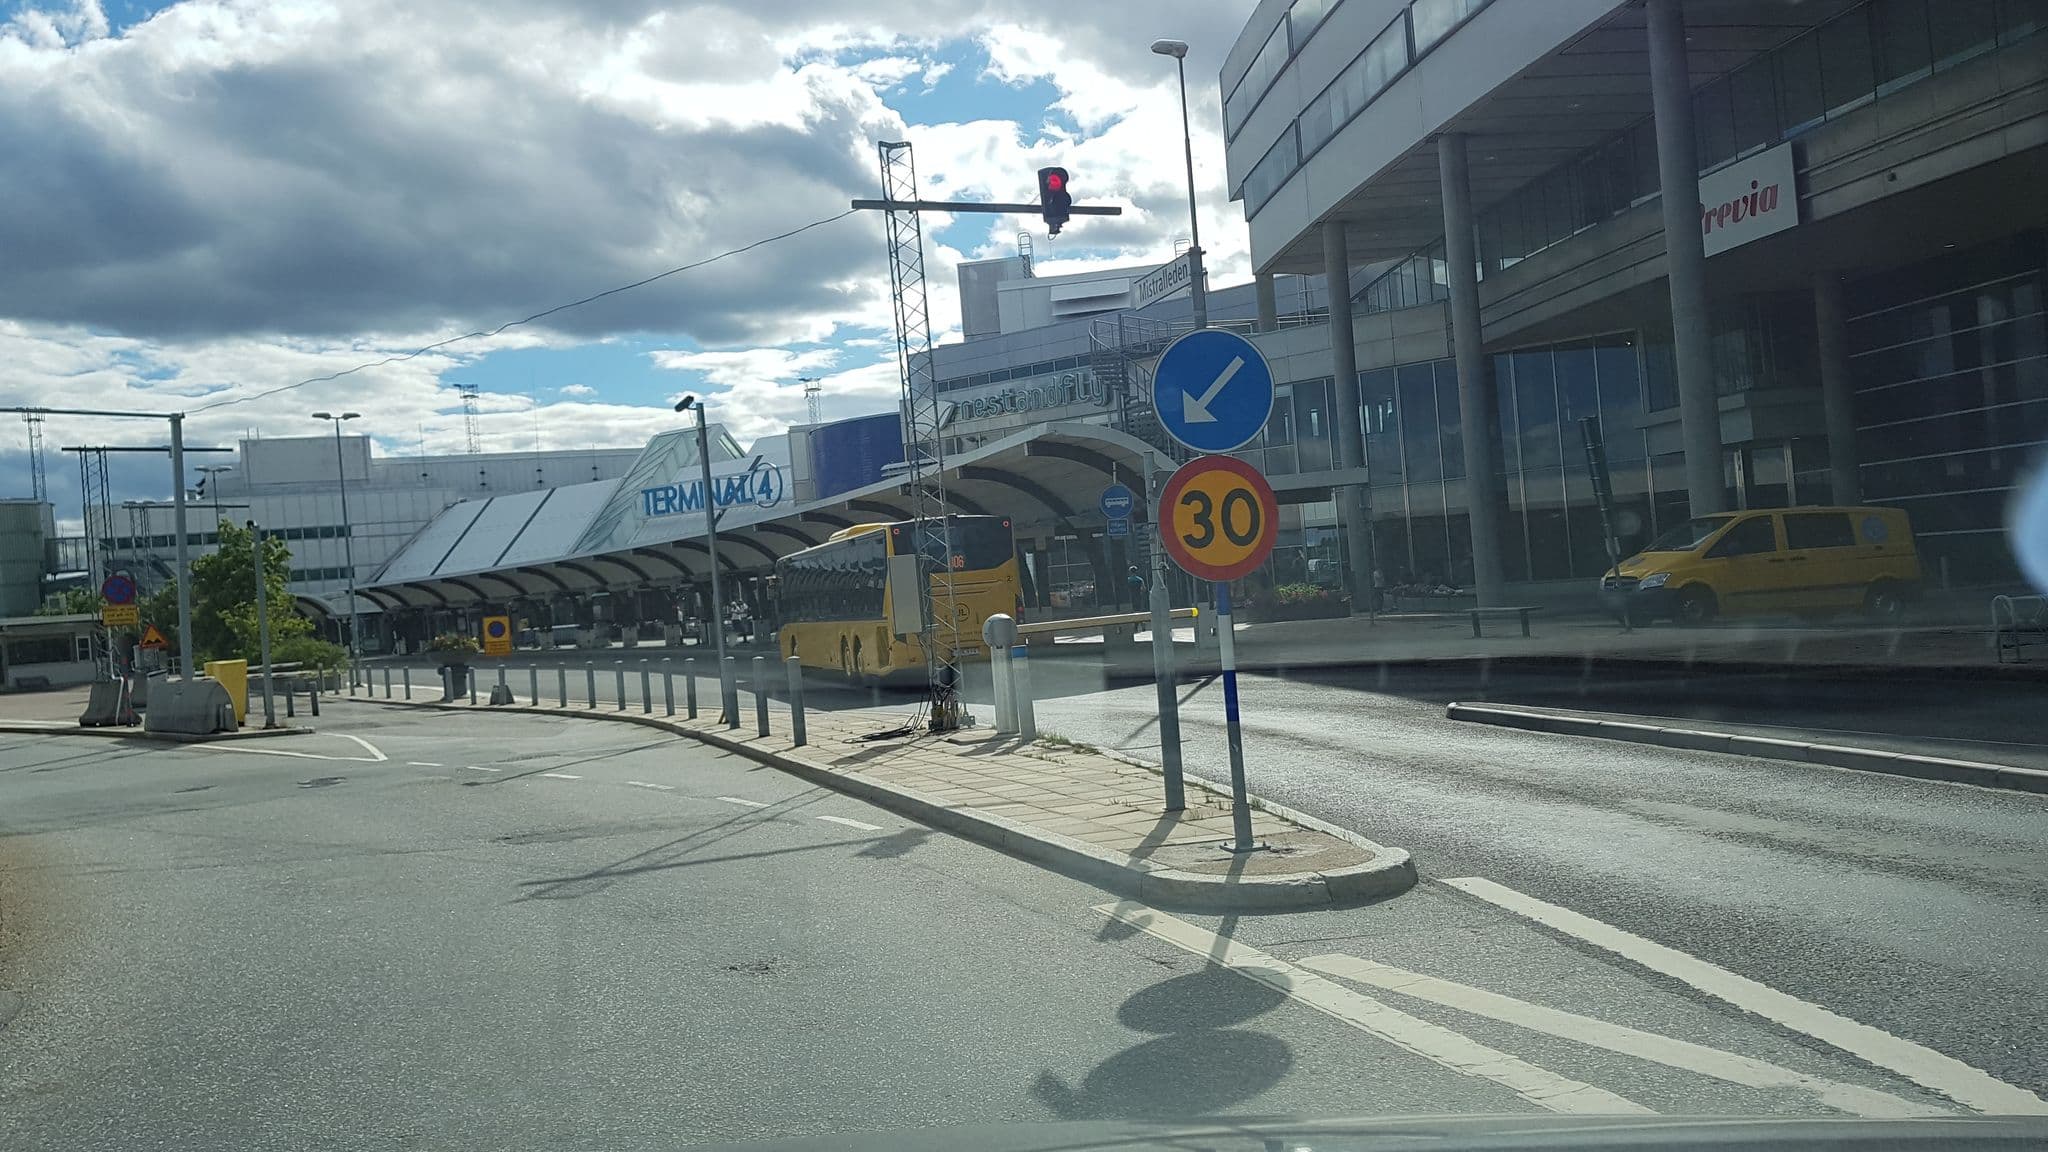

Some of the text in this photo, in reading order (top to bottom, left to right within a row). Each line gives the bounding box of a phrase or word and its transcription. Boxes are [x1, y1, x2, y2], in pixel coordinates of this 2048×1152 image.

[1700, 180, 1779, 235] revia
[1139, 262, 1189, 302] Mistralleden
[641, 470, 773, 516] TERMINAL 4
[1181, 488, 1260, 549] 30
